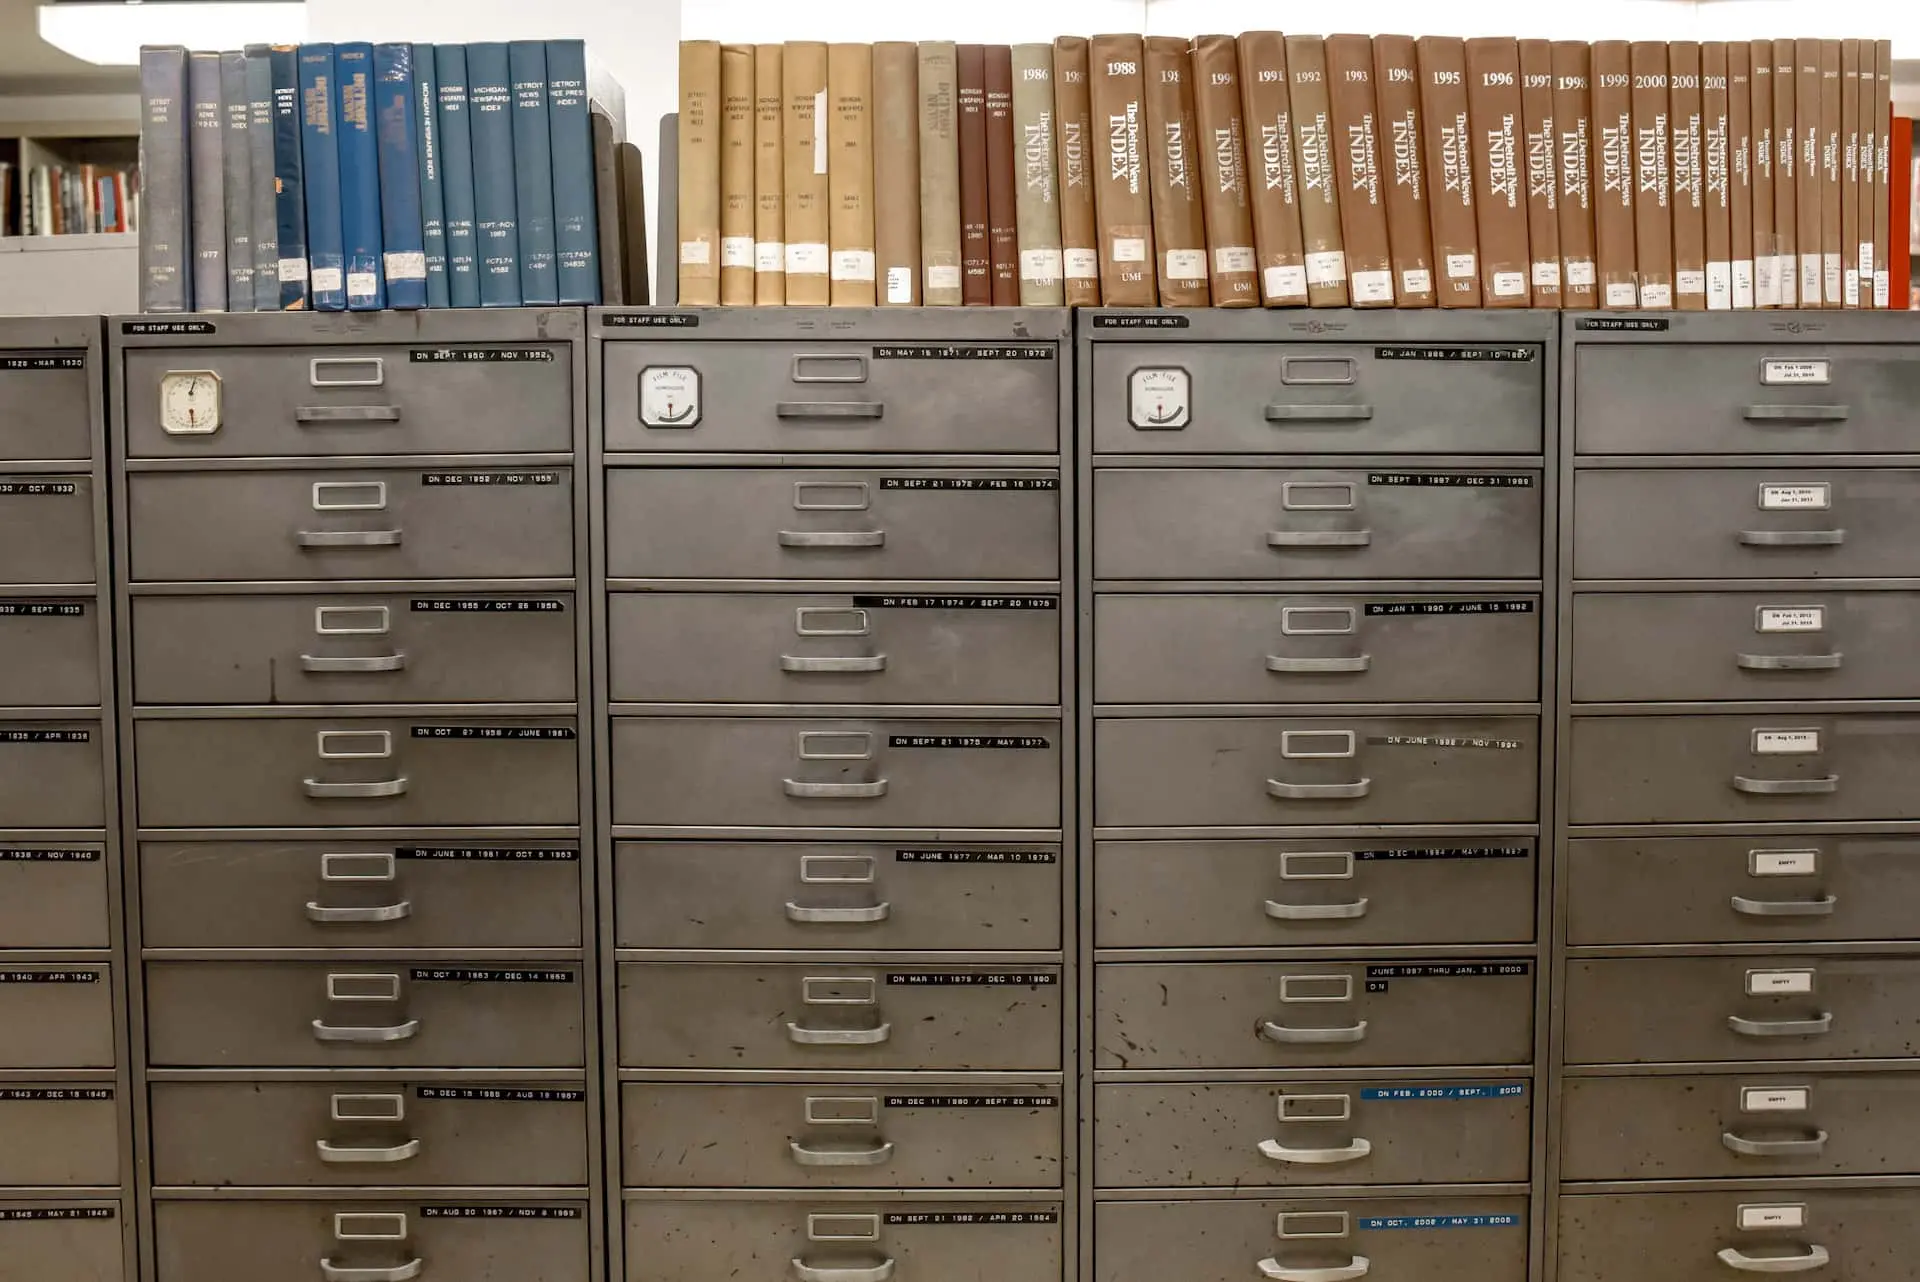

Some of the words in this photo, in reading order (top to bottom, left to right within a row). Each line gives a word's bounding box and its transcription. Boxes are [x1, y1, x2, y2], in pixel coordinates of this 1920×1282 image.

[1024, 68, 1048, 80] 1986
[1108, 62, 1136, 76] 1988
[1258, 70, 1283, 82] 1991
[1296, 71, 1321, 83] 1992
[1345, 71, 1368, 82] 1993
[1388, 68, 1414, 83] 1994
[1432, 71, 1460, 85] 1995
[1482, 72, 1513, 86] 1996
[514, 82, 544, 90] DETROIT
[1523, 75, 1551, 87] 1997
[1600, 74, 1630, 87] 1999
[1635, 75, 1668, 88] 2000
[1671, 75, 1700, 89] 2001
[1703, 75, 1727, 89] 2002
[1127, 101, 1138, 123] The
[1456, 112, 1467, 134] The
[1503, 114, 1514, 136] The
[1656, 113, 1666, 135] The
[1110, 114, 1129, 181] INDEX
[1127, 123, 1138, 164] Detroit
[1166, 121, 1185, 188] INDEX
[1392, 120, 1411, 185] INDEX
[1024, 124, 1043, 191] INDEX
[1065, 121, 1082, 189] INDEX
[1216, 128, 1237, 193] INDEX
[1262, 125, 1282, 190] INDEX
[1300, 125, 1322, 190] INDEX
[1349, 125, 1368, 190] INDEX
[1441, 126, 1460, 192] INDEX
[1458, 135, 1469, 175] Detroit
[1488, 130, 1508, 195] INDEX
[1505, 137, 1516, 176] Detroit
[1528, 132, 1547, 197] INDEX
[1562, 131, 1580, 196] INDEX
[1602, 127, 1621, 192] INDEX
[1639, 127, 1657, 192] INDEX
[1657, 136, 1668, 175] Detroit
[1673, 127, 1691, 192] INDEX
[1707, 127, 1721, 192] INDEX
[1129, 164, 1140, 194] News
[1462, 175, 1471, 206] News
[1507, 177, 1518, 208] News
[1658, 176, 1668, 207] News
[1121, 272, 1141, 282] UMI
[1234, 282, 1252, 292] UMI
[1400, 350, 1416, 358] JAN
[1389, 476, 1411, 484] SEPT
[1406, 736, 1427, 745] JUNE
[1473, 739, 1489, 747] NOV
[1389, 849, 1407, 857] DEC
[988, 975, 1005, 983] DEC
[1372, 967, 1394, 975] JUNE
[1456, 966, 1475, 974] JAN.
[1395, 1089, 1414, 1097] FEB.
[1452, 1217, 1468, 1225] MAY
